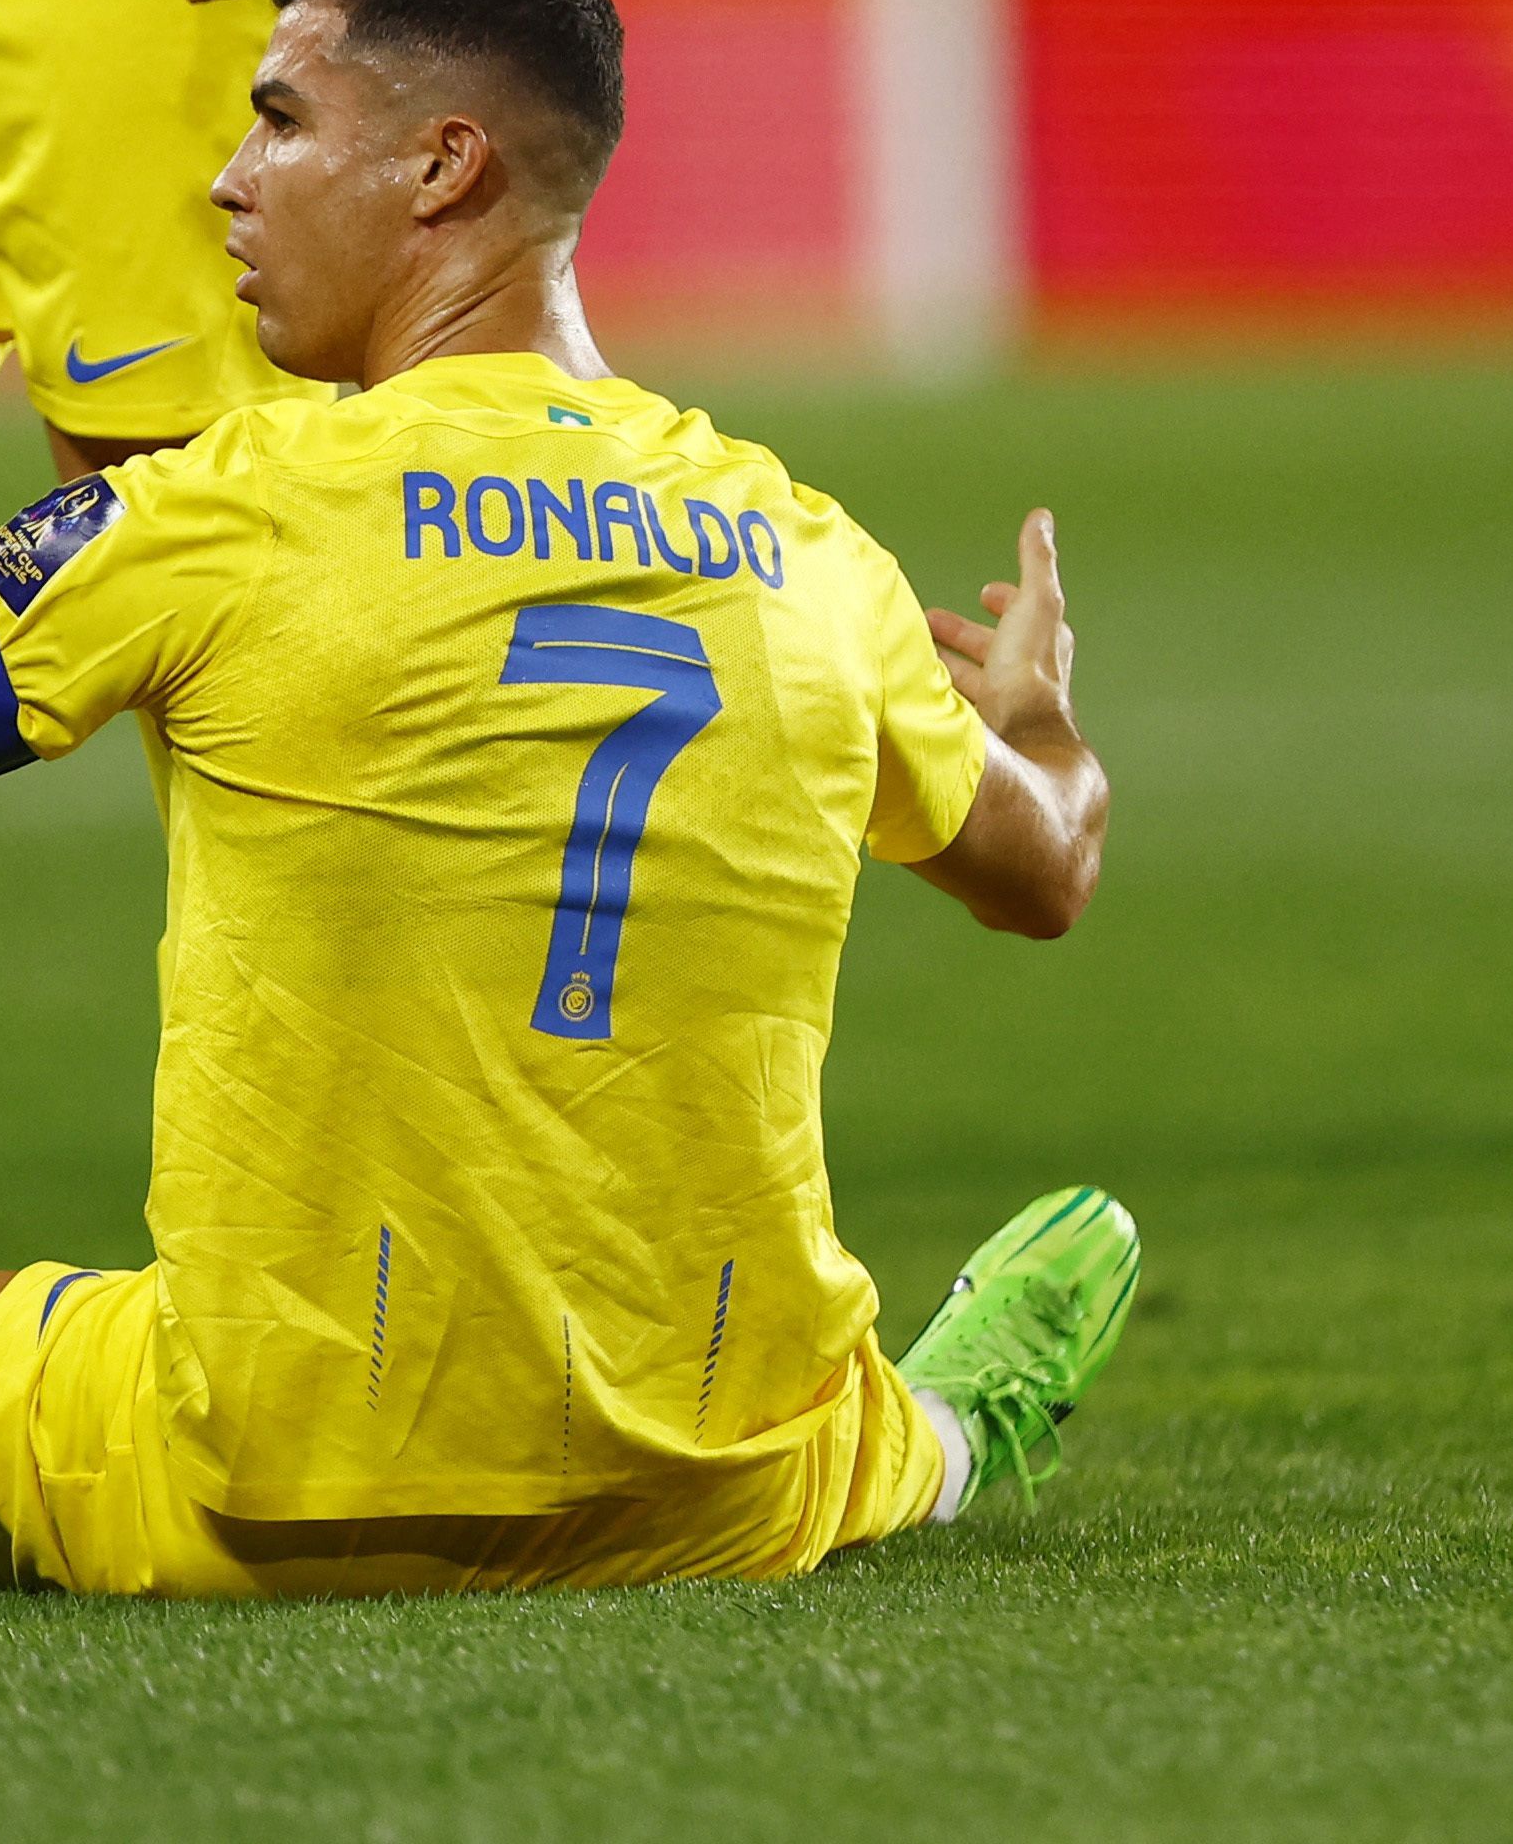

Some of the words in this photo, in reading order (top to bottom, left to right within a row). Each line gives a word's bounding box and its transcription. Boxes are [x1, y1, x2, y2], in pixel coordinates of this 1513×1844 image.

[18, 553, 43, 581] CUP
[403, 471, 784, 589] RONALDO
[499, 604, 722, 1040] 7
